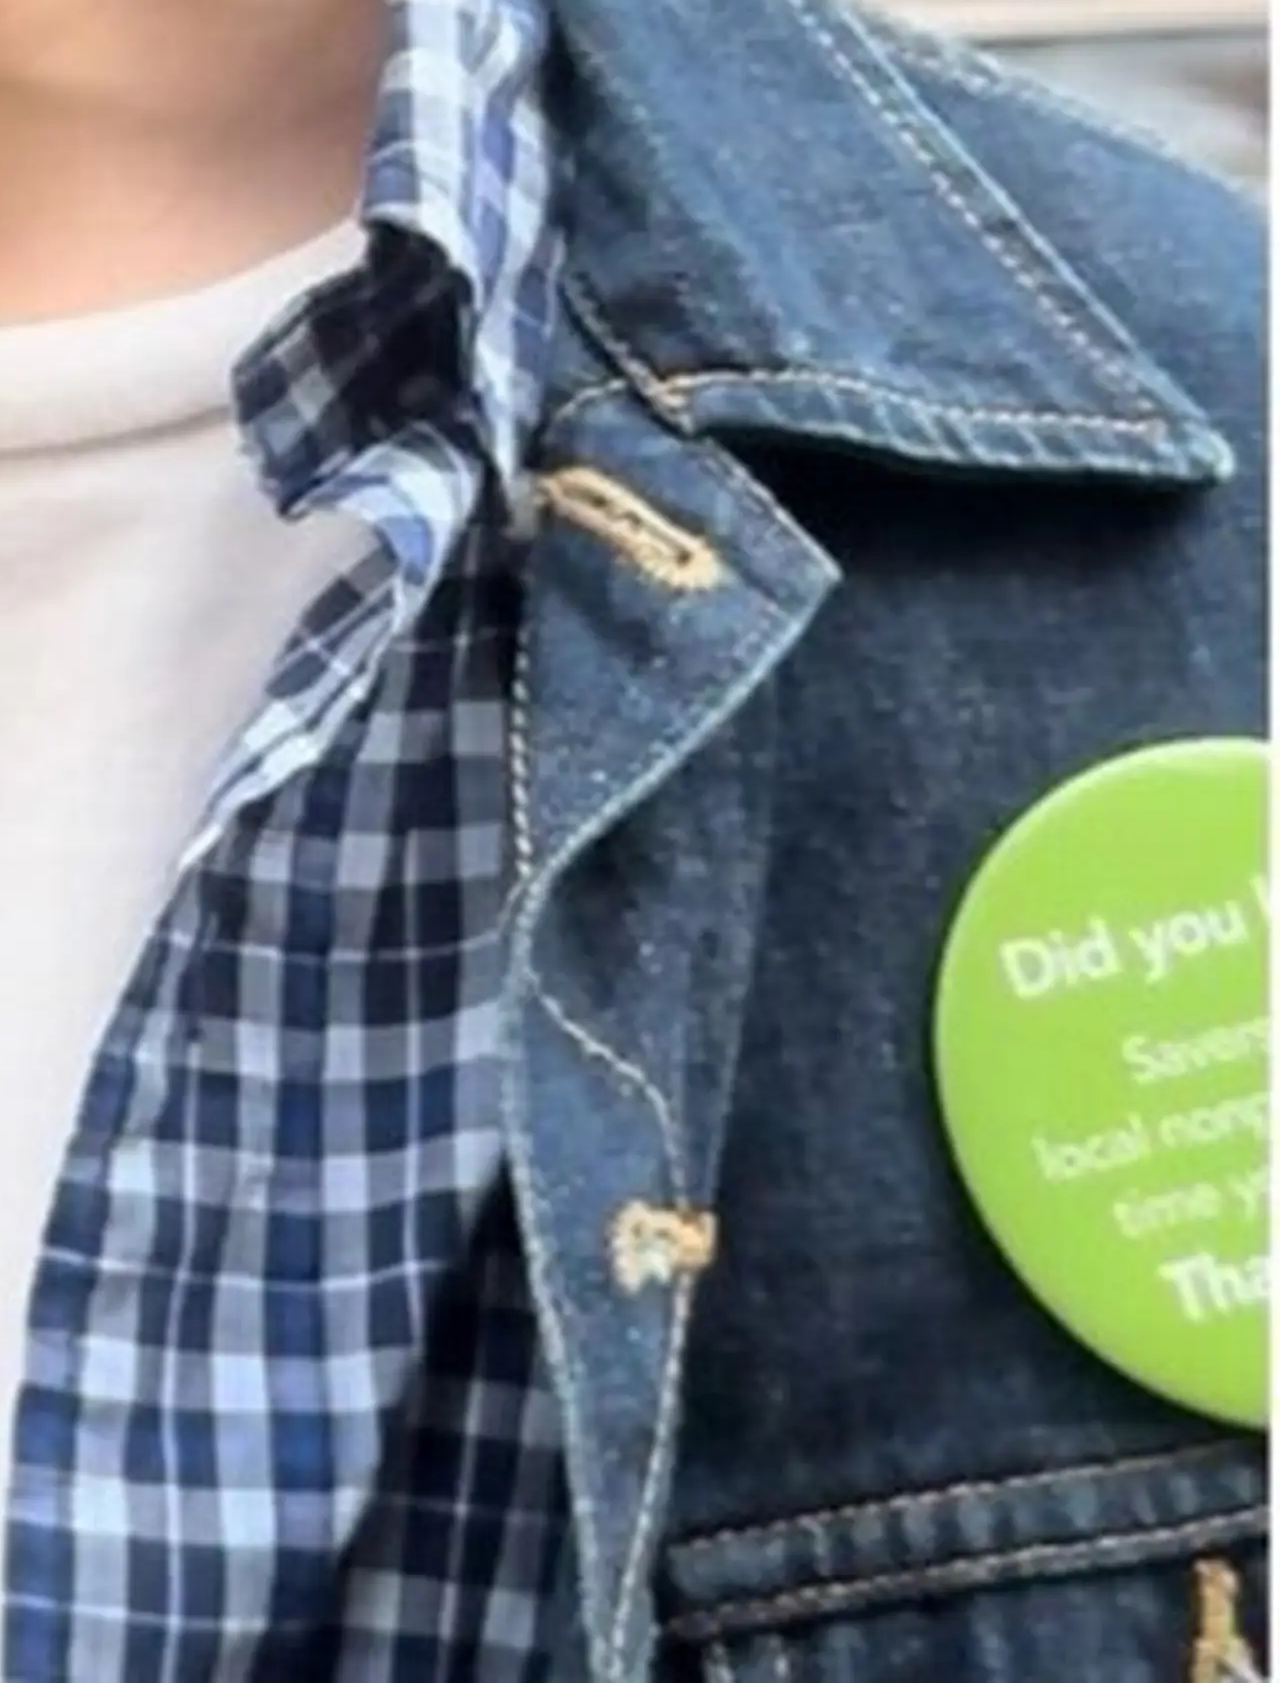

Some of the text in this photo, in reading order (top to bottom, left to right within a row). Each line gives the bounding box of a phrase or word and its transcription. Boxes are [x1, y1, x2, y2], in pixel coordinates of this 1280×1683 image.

[998, 899, 1249, 1001] Did you
[1030, 1111, 1151, 1181] local
[1112, 1182, 1222, 1240] time
